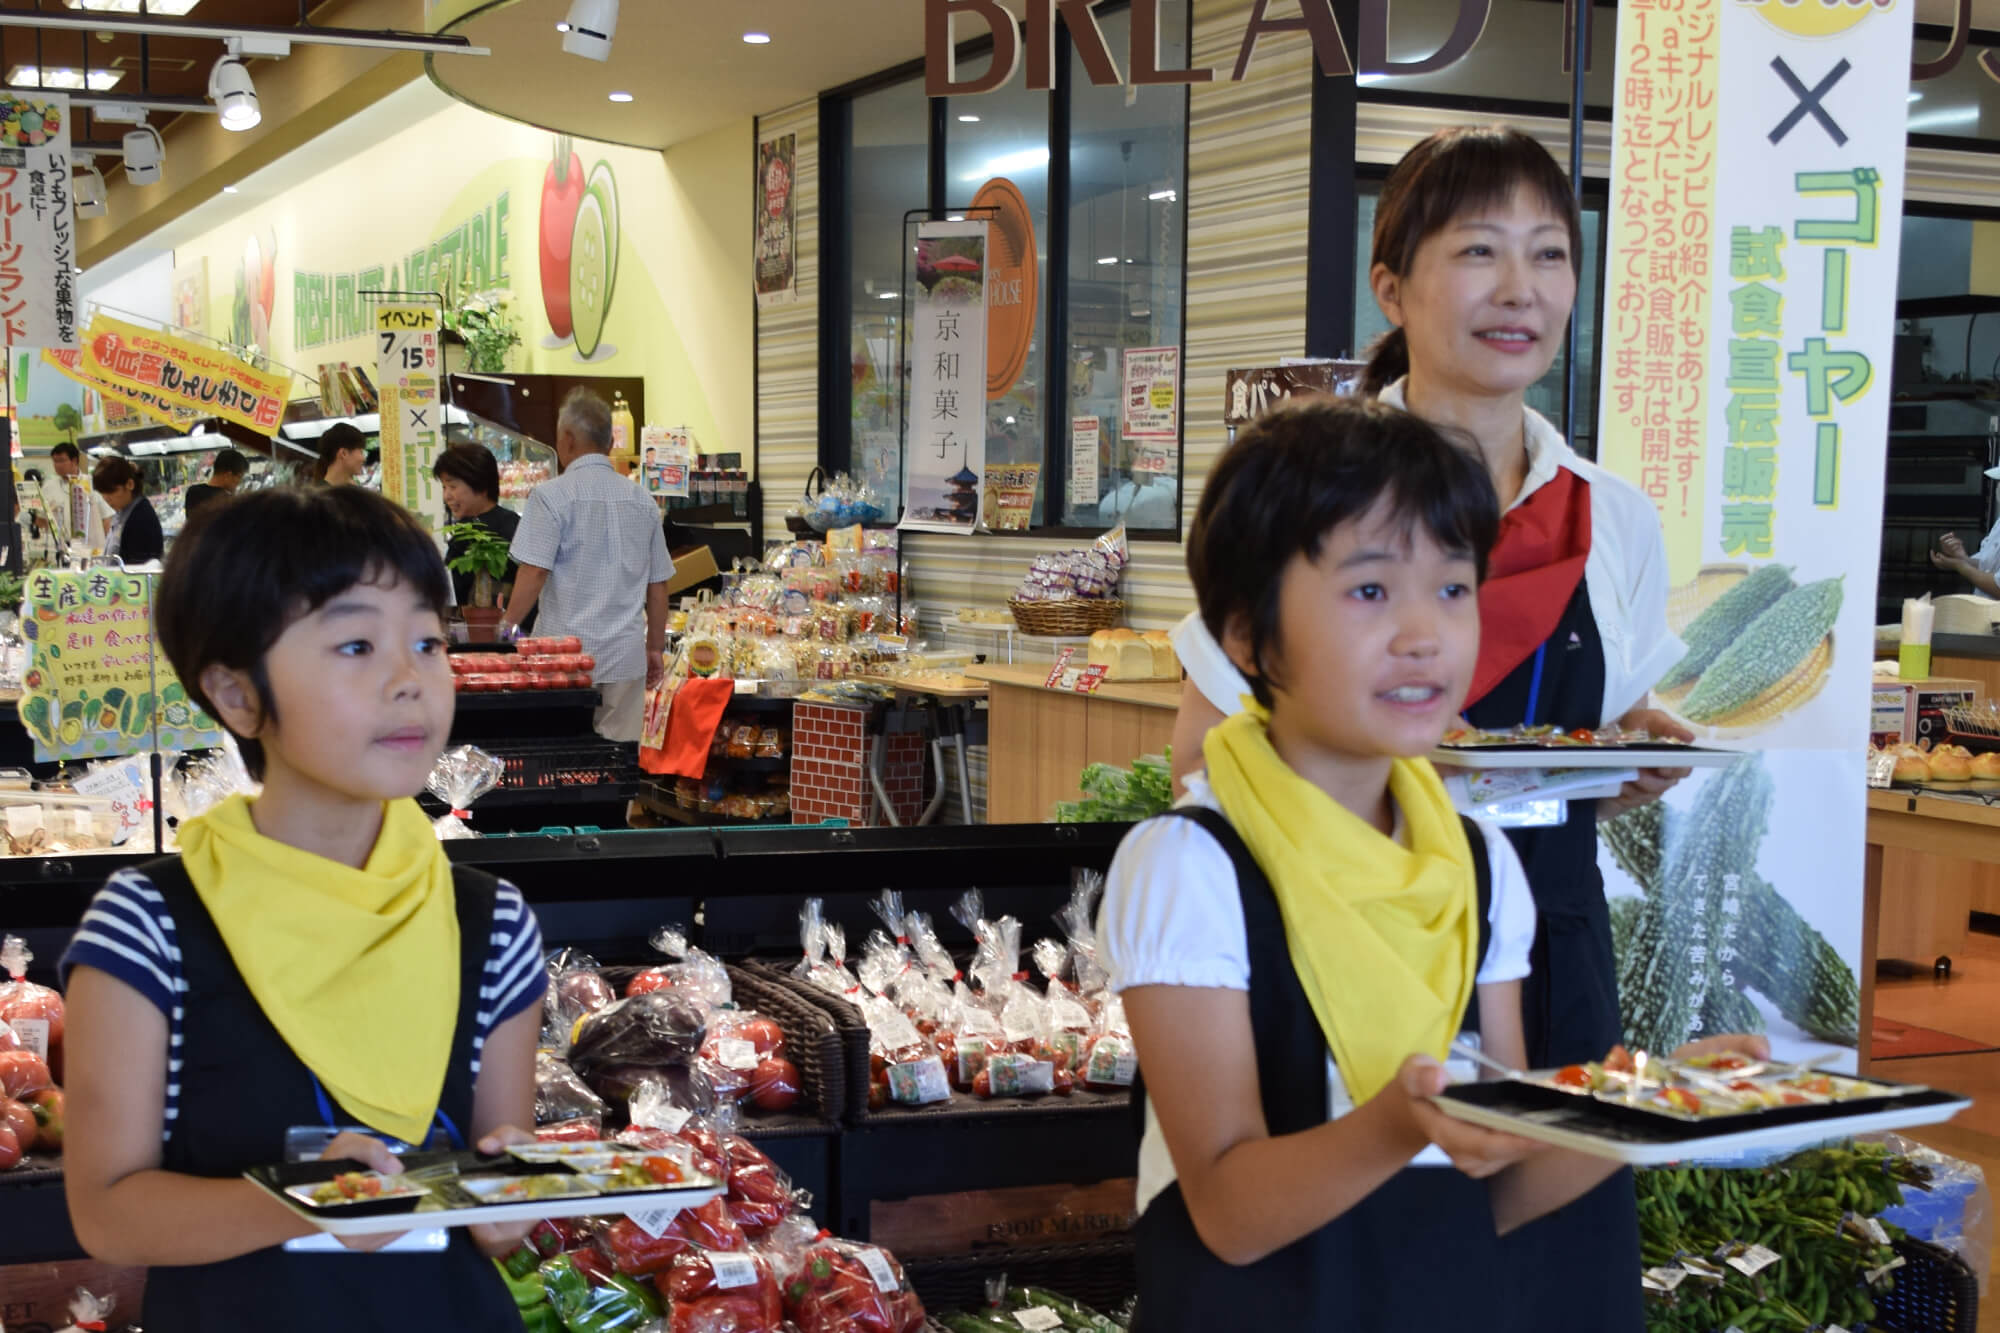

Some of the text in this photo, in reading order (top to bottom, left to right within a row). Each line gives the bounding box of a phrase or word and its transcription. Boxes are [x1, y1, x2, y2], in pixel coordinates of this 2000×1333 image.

[49, 153, 74, 344] いつもフレッシュな果物を
[379, 311, 434, 329] イベント
[1613, 0, 1654, 427] 12時迄となっております。
[1672, 0, 1715, 517] ジナルレシピの紹介もあります!
[1787, 167, 1882, 510] ゴーヤー
[930, 310, 961, 460] 京和菓子
[1720, 225, 1786, 557] 試食宣伝販売
